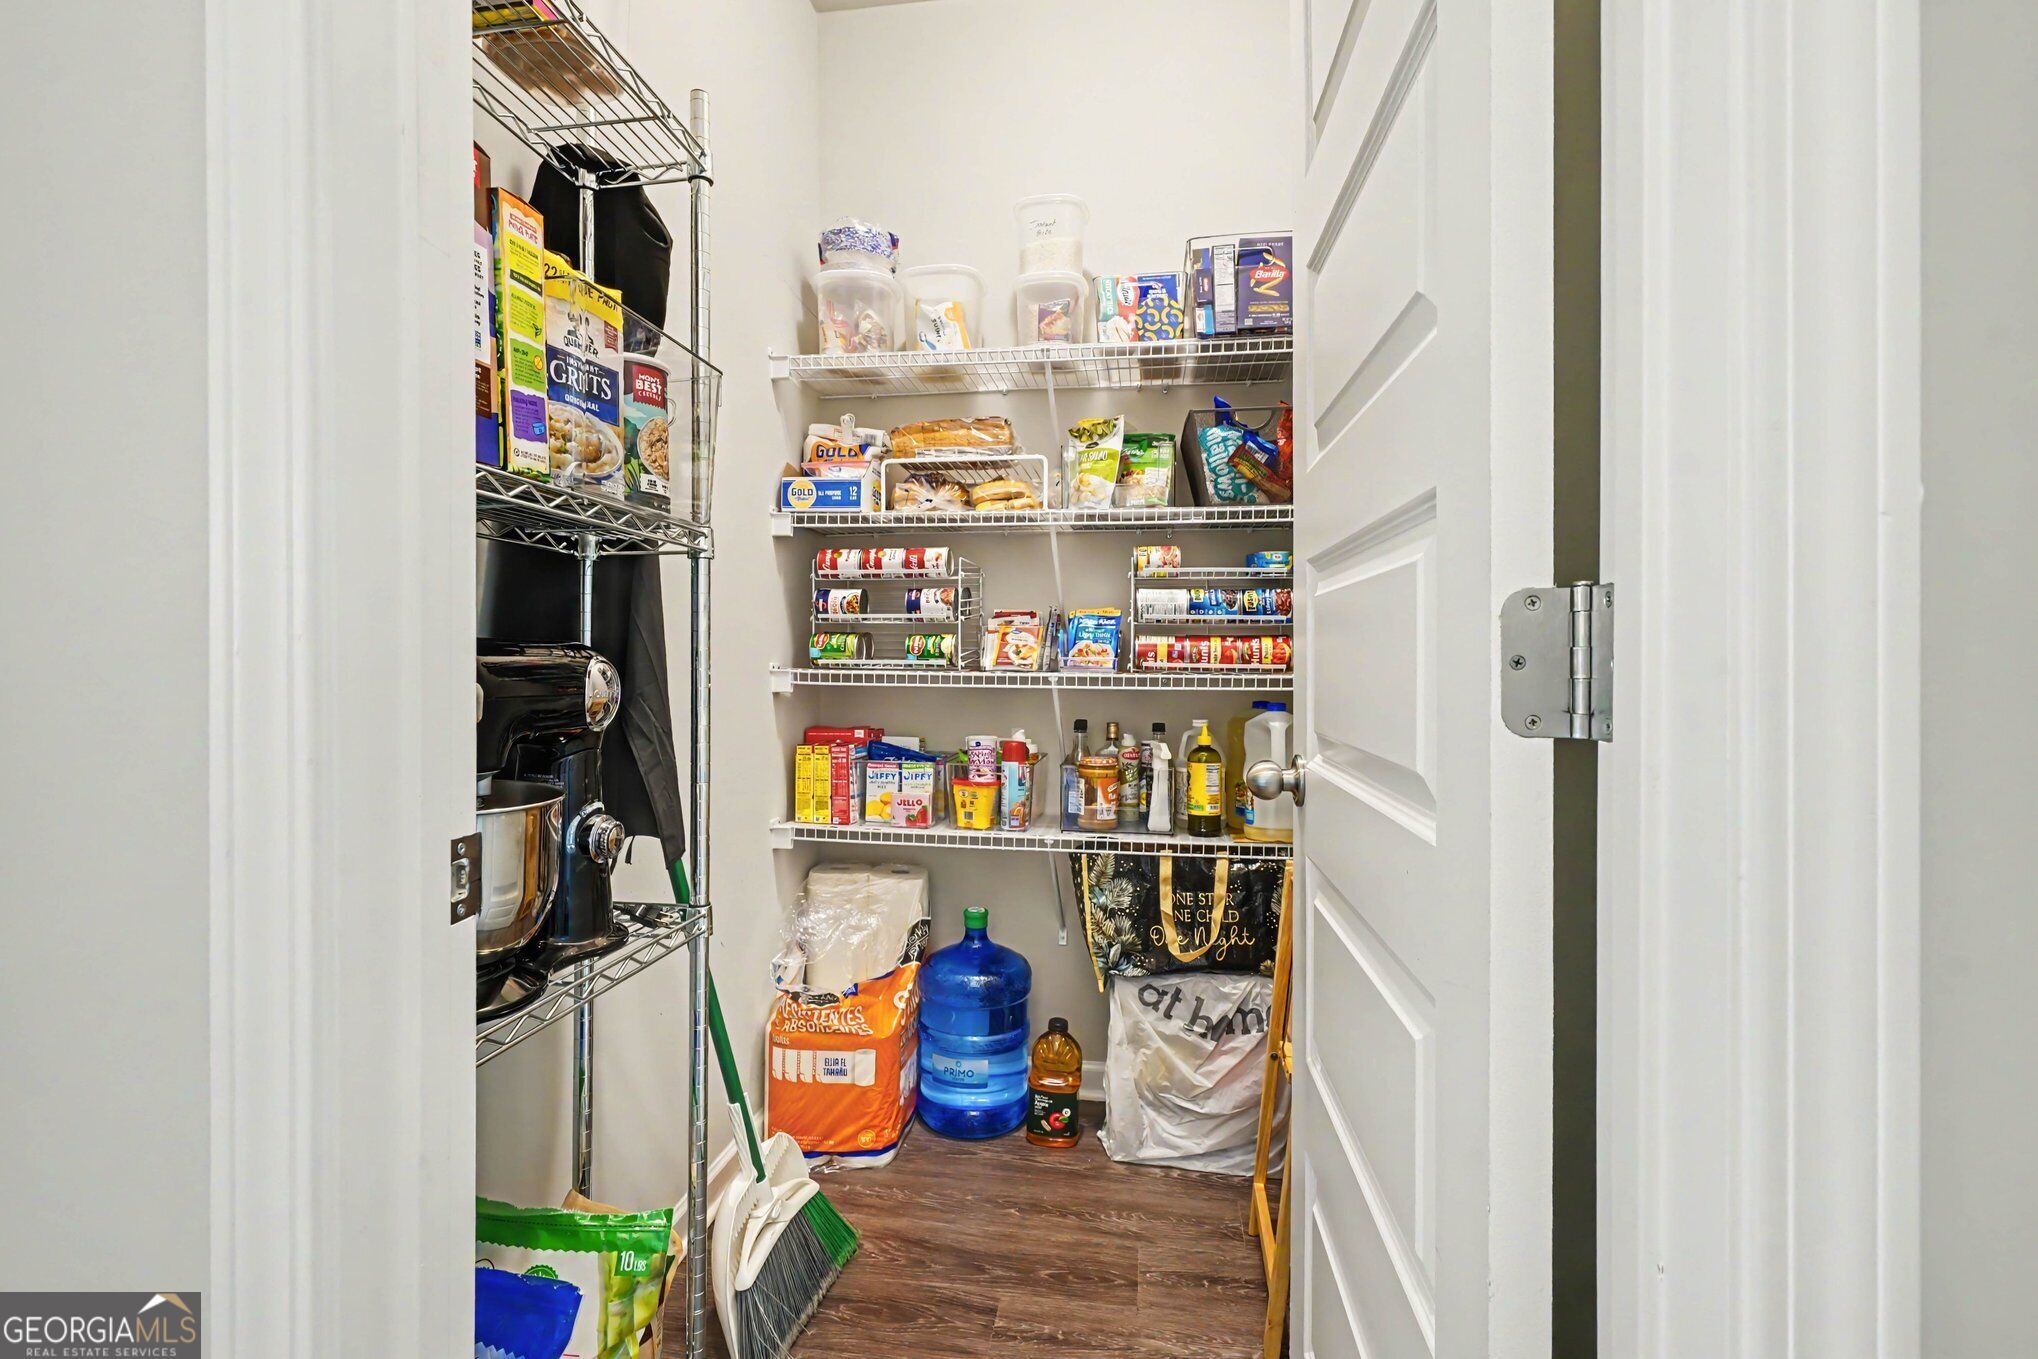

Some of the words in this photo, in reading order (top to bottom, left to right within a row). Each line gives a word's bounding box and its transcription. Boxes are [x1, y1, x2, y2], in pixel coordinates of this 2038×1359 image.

[635, 379, 662, 395] BEST
[791, 487, 814, 497] GOLD
[868, 770, 897, 781] JIFFY
[903, 770, 933, 781] JIFFY
[1198, 892, 1235, 906] STR
[1174, 909, 1192, 923] NE
[1196, 909, 1240, 923] CHLD
[1149, 925, 1190, 947] Oe
[1194, 925, 1256, 961] Nght
[1138, 983, 1182, 1020] at
[943, 1066, 975, 1079] PRIMO
[620, 1251, 633, 1272] 10
[634, 1259, 647, 1272] LBS
